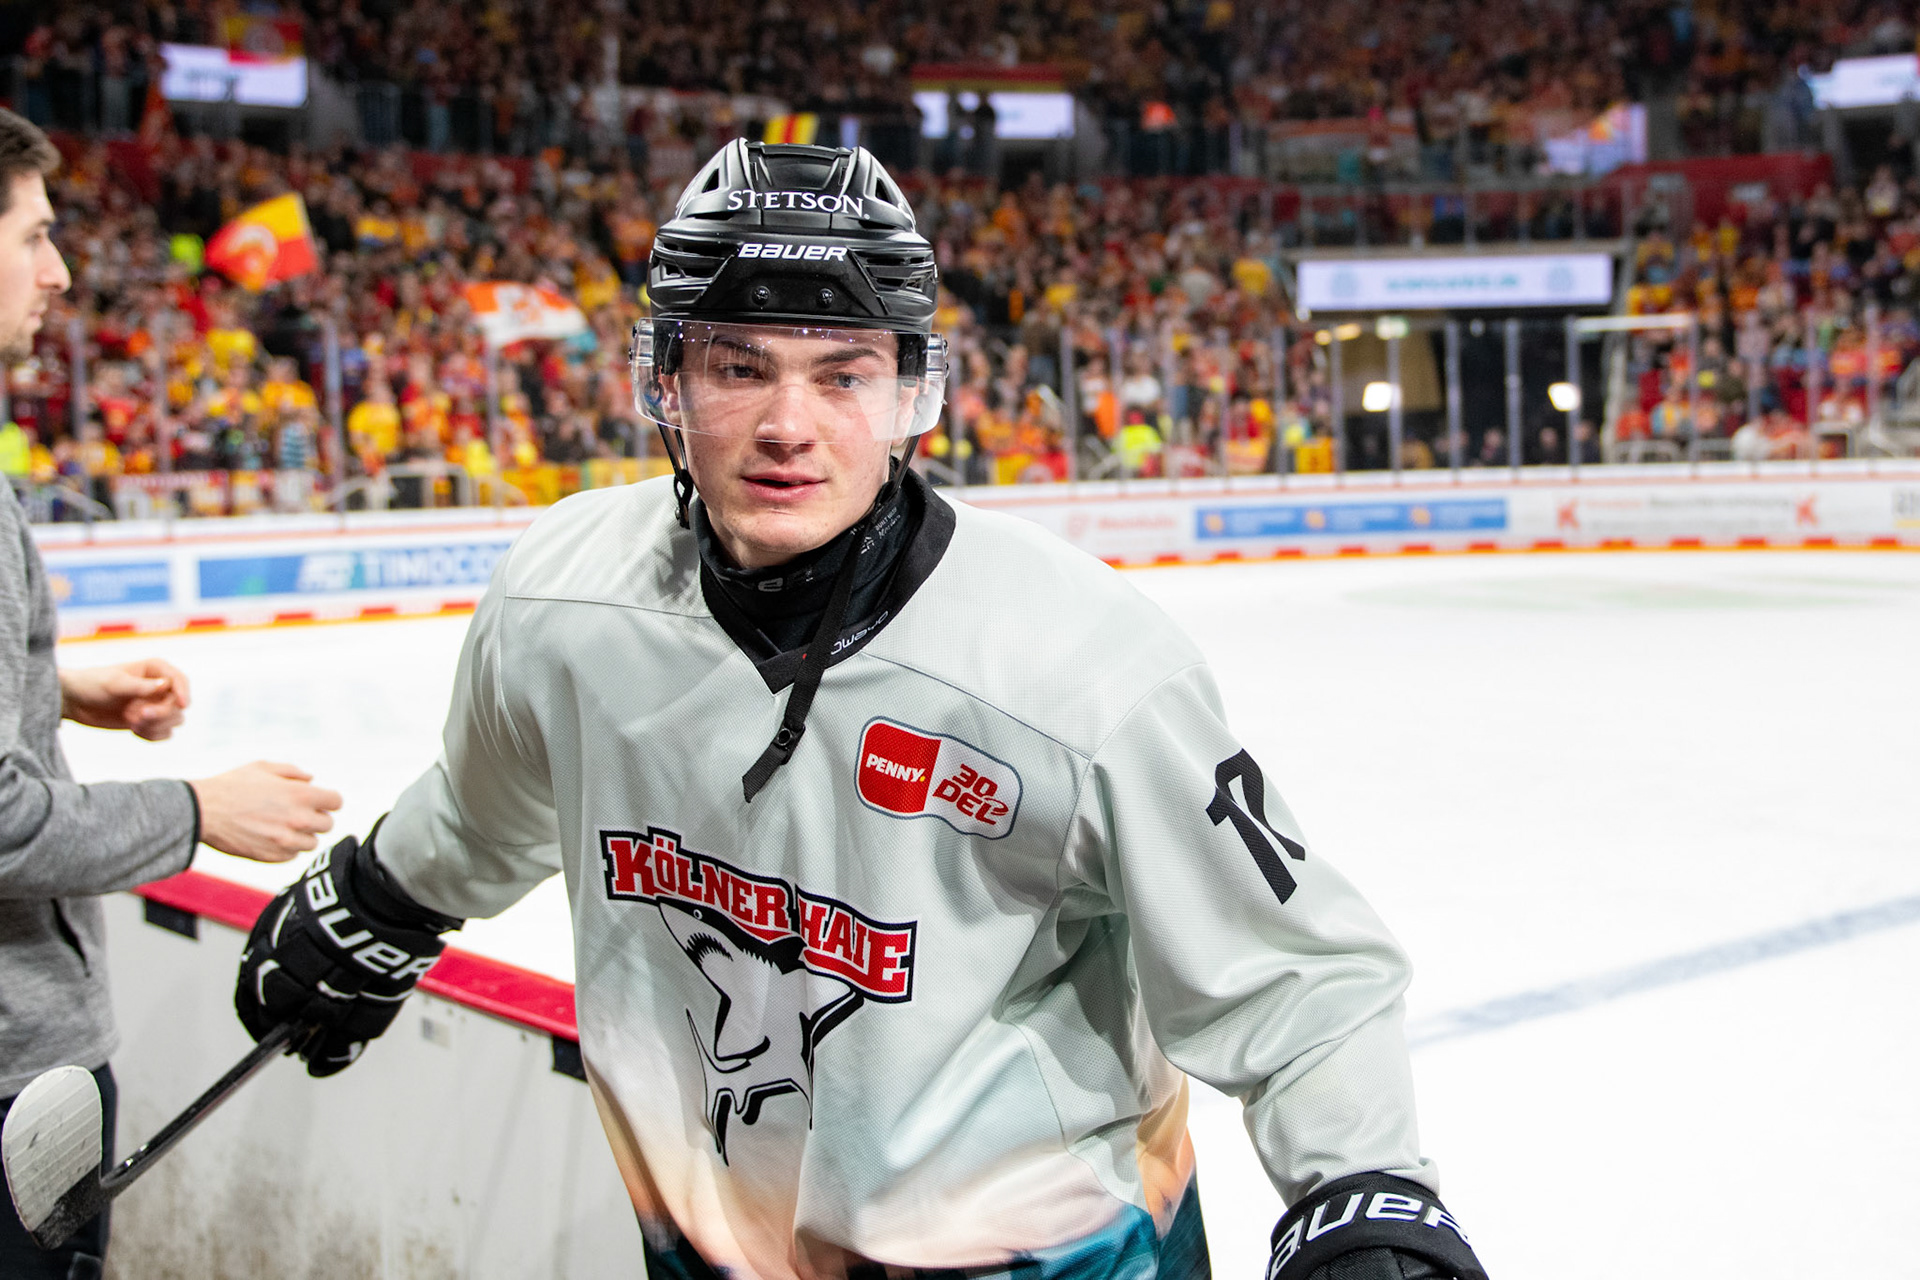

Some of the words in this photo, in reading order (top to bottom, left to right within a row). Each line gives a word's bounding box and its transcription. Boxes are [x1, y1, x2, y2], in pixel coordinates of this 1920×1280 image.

[727, 189, 865, 218] STETSON
[738, 243, 848, 262] BAUER
[952, 763, 998, 797] 30
[932, 778, 997, 826] DEL
[608, 836, 793, 931] KÖLNER
[797, 894, 910, 995] HAIE
[1268, 1192, 1470, 1280] AUER
